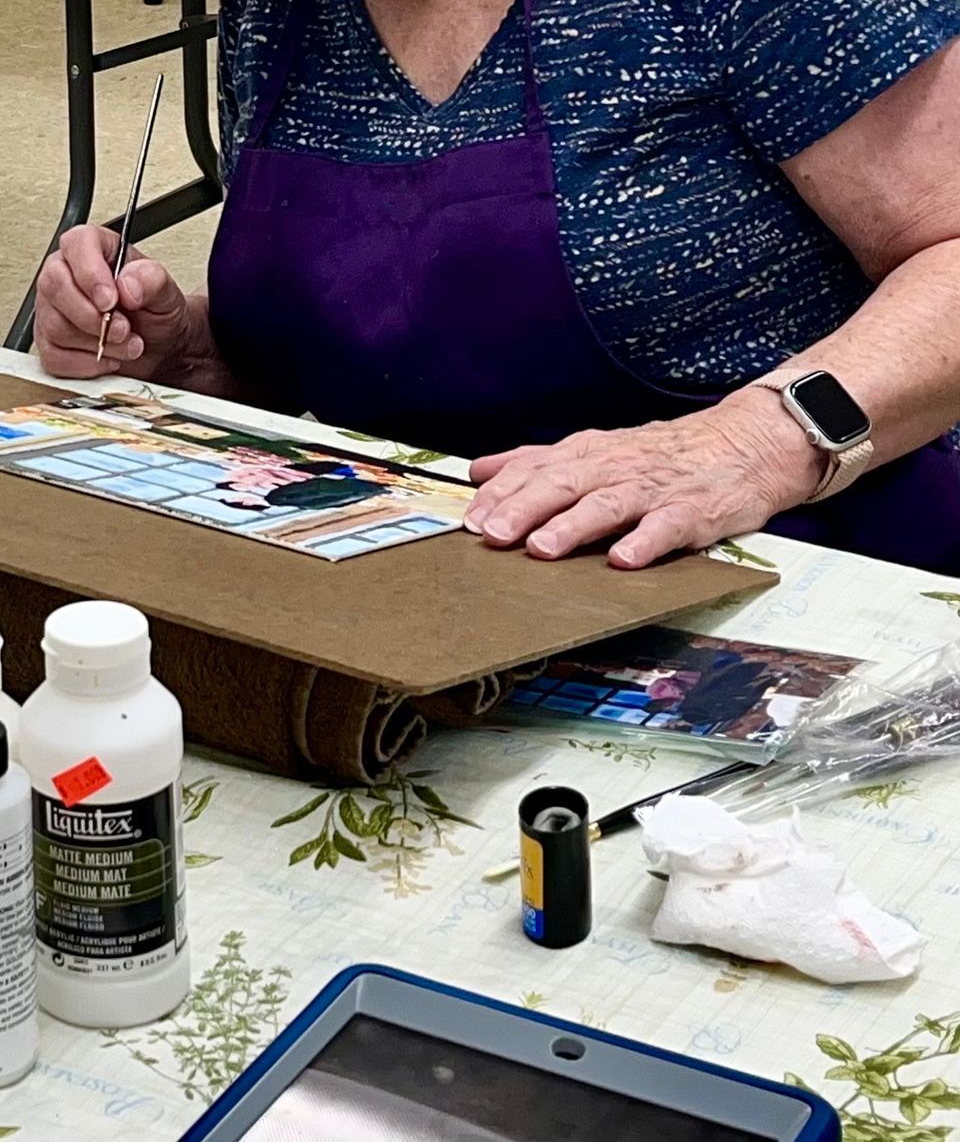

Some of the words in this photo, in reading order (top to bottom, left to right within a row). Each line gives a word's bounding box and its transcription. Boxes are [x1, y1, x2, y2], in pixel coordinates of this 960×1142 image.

[46, 800, 134, 841] Liquitex
[49, 845, 82, 865] MATTE
[86, 850, 134, 867] MEDIUM
[55, 863, 100, 883] MEDIUM
[104, 867, 128, 882] MAT
[53, 879, 98, 899] MEDIUM
[101, 884, 132, 899] MATE
